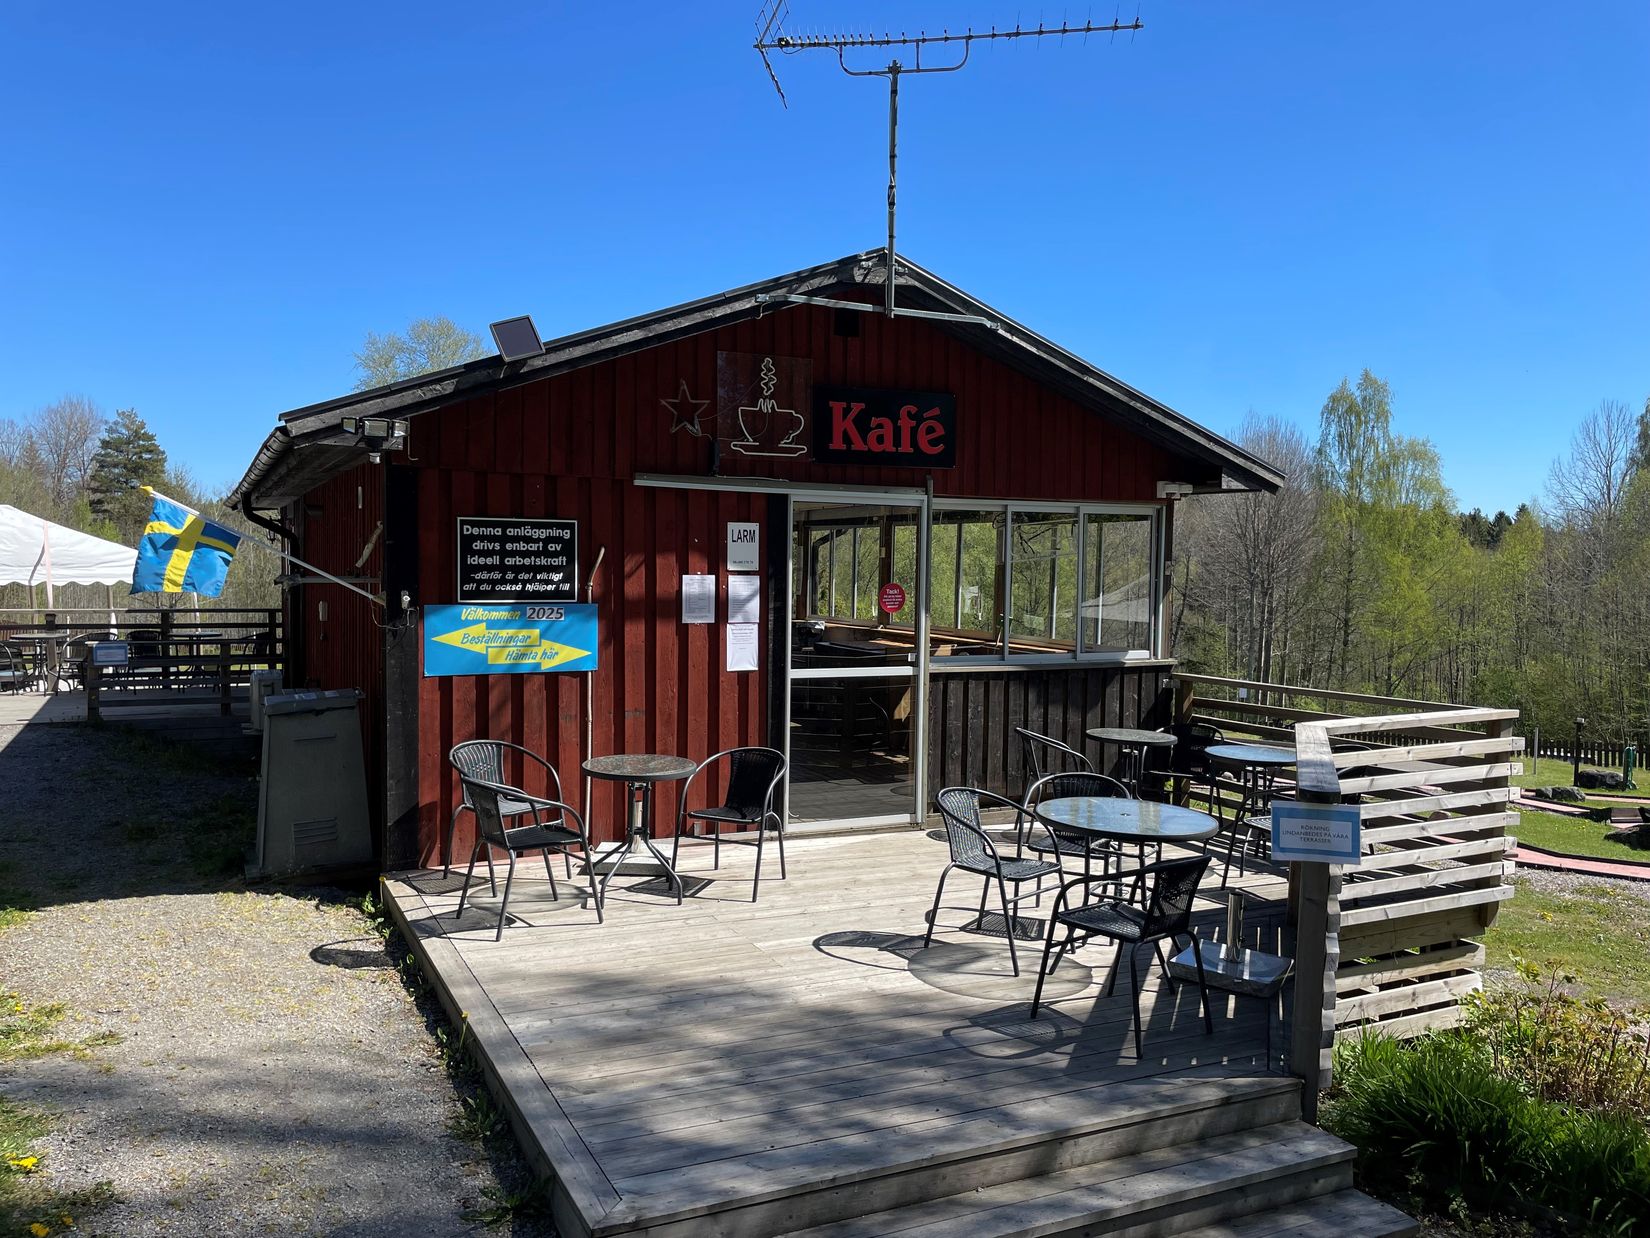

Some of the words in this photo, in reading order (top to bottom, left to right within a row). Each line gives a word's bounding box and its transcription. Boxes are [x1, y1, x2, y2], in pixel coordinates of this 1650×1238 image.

[829, 401, 945, 455] Kafé
[463, 525, 502, 536] Denna
[506, 526, 571, 539] anläggning
[731, 529, 756, 543] LARM
[472, 540, 500, 551] drivs
[505, 541, 543, 551] enbart
[548, 542, 562, 551] av
[467, 555, 500, 565] ideell
[504, 555, 567, 566] arbetskraft
[505, 571, 515, 580] är
[518, 571, 533, 580] det
[536, 572, 563, 582] viktigt
[463, 583, 476, 591] att
[480, 583, 491, 591] du
[495, 582, 522, 591] också
[525, 582, 556, 592] hjälper
[559, 583, 570, 591] till
[461, 607, 521, 620] Välkommen
[527, 607, 564, 620] 2025
[461, 631, 531, 646] Beställningar
[504, 648, 539, 662] Hämta
[540, 647, 559, 660] här
